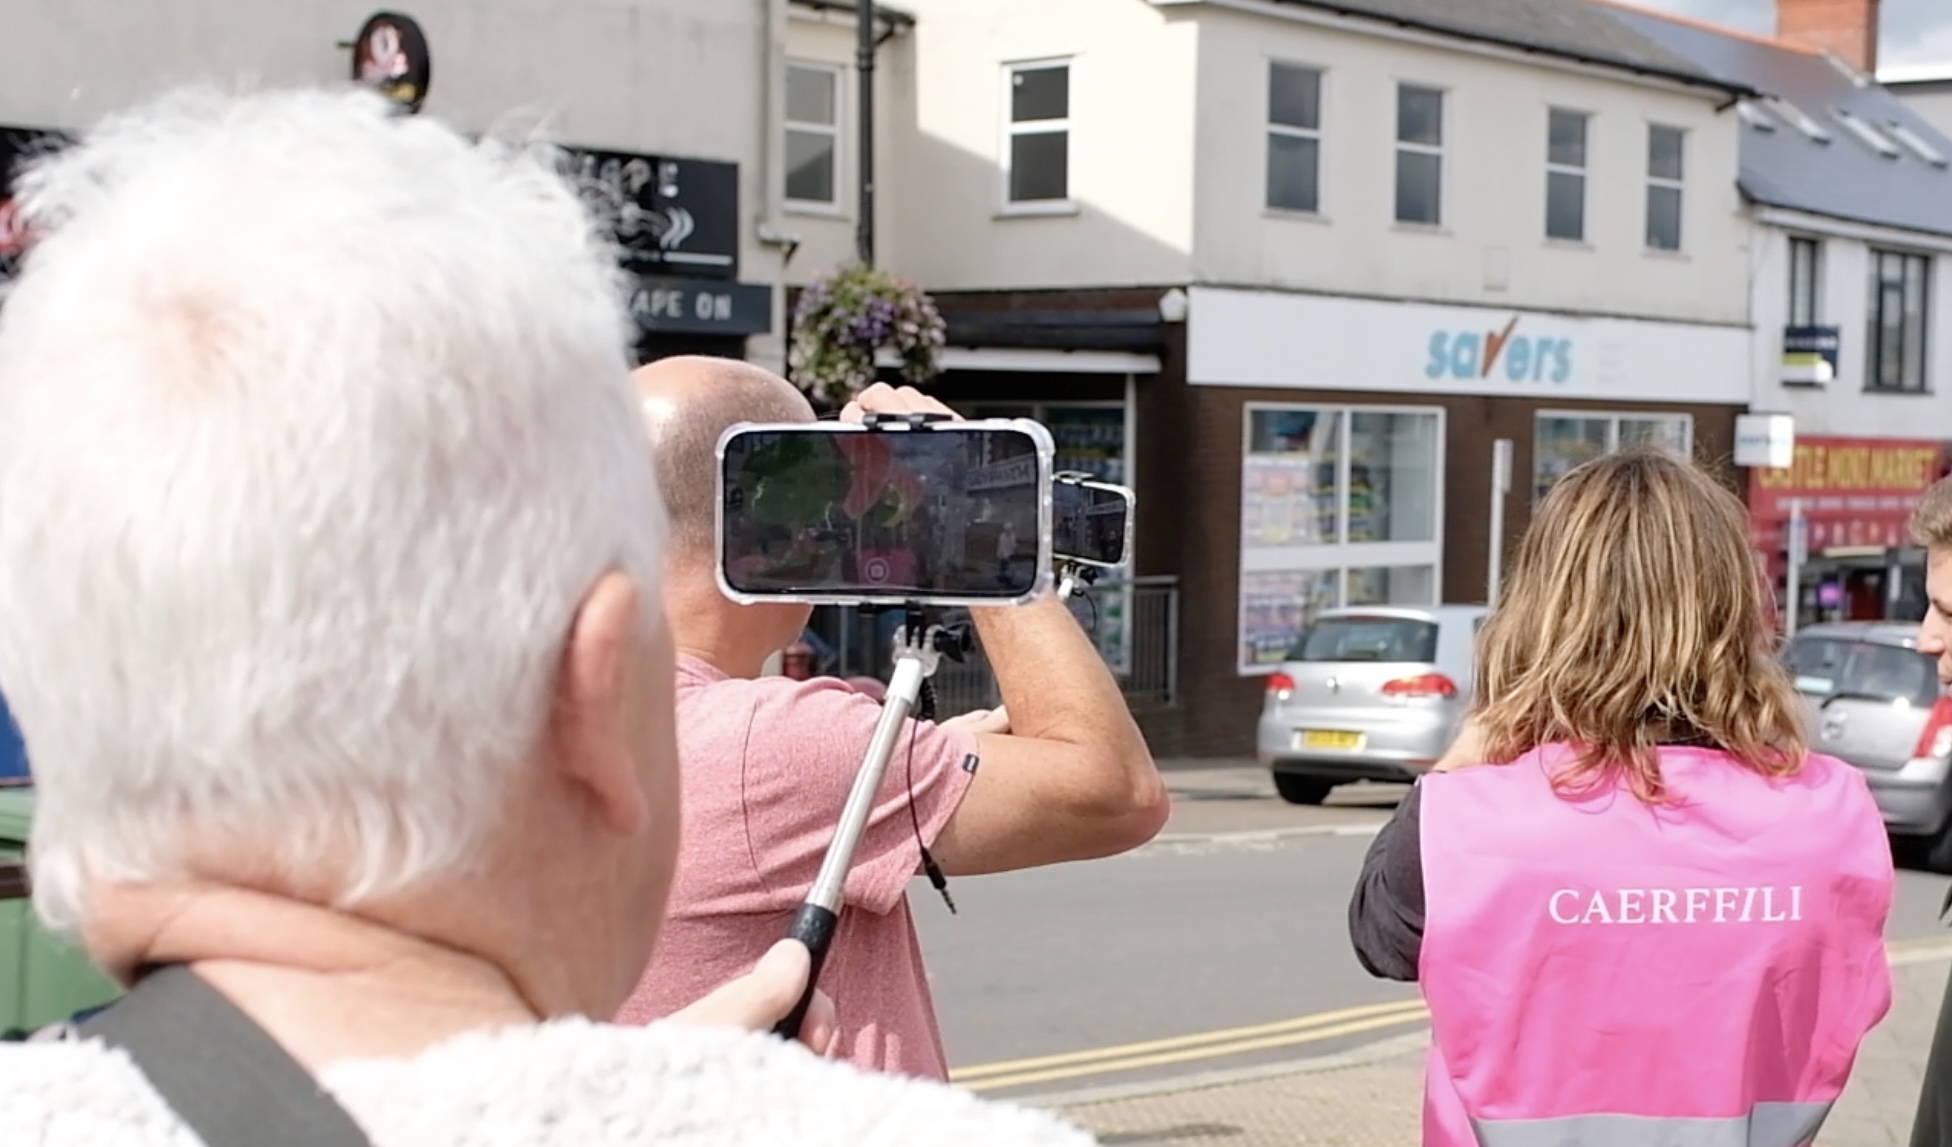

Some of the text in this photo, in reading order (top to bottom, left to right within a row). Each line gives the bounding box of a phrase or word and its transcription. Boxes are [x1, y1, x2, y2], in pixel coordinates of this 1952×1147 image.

[631, 289, 732, 320] APE ON
[1424, 314, 1572, 383] savers
[1549, 886, 1802, 924] CAERFFILI
